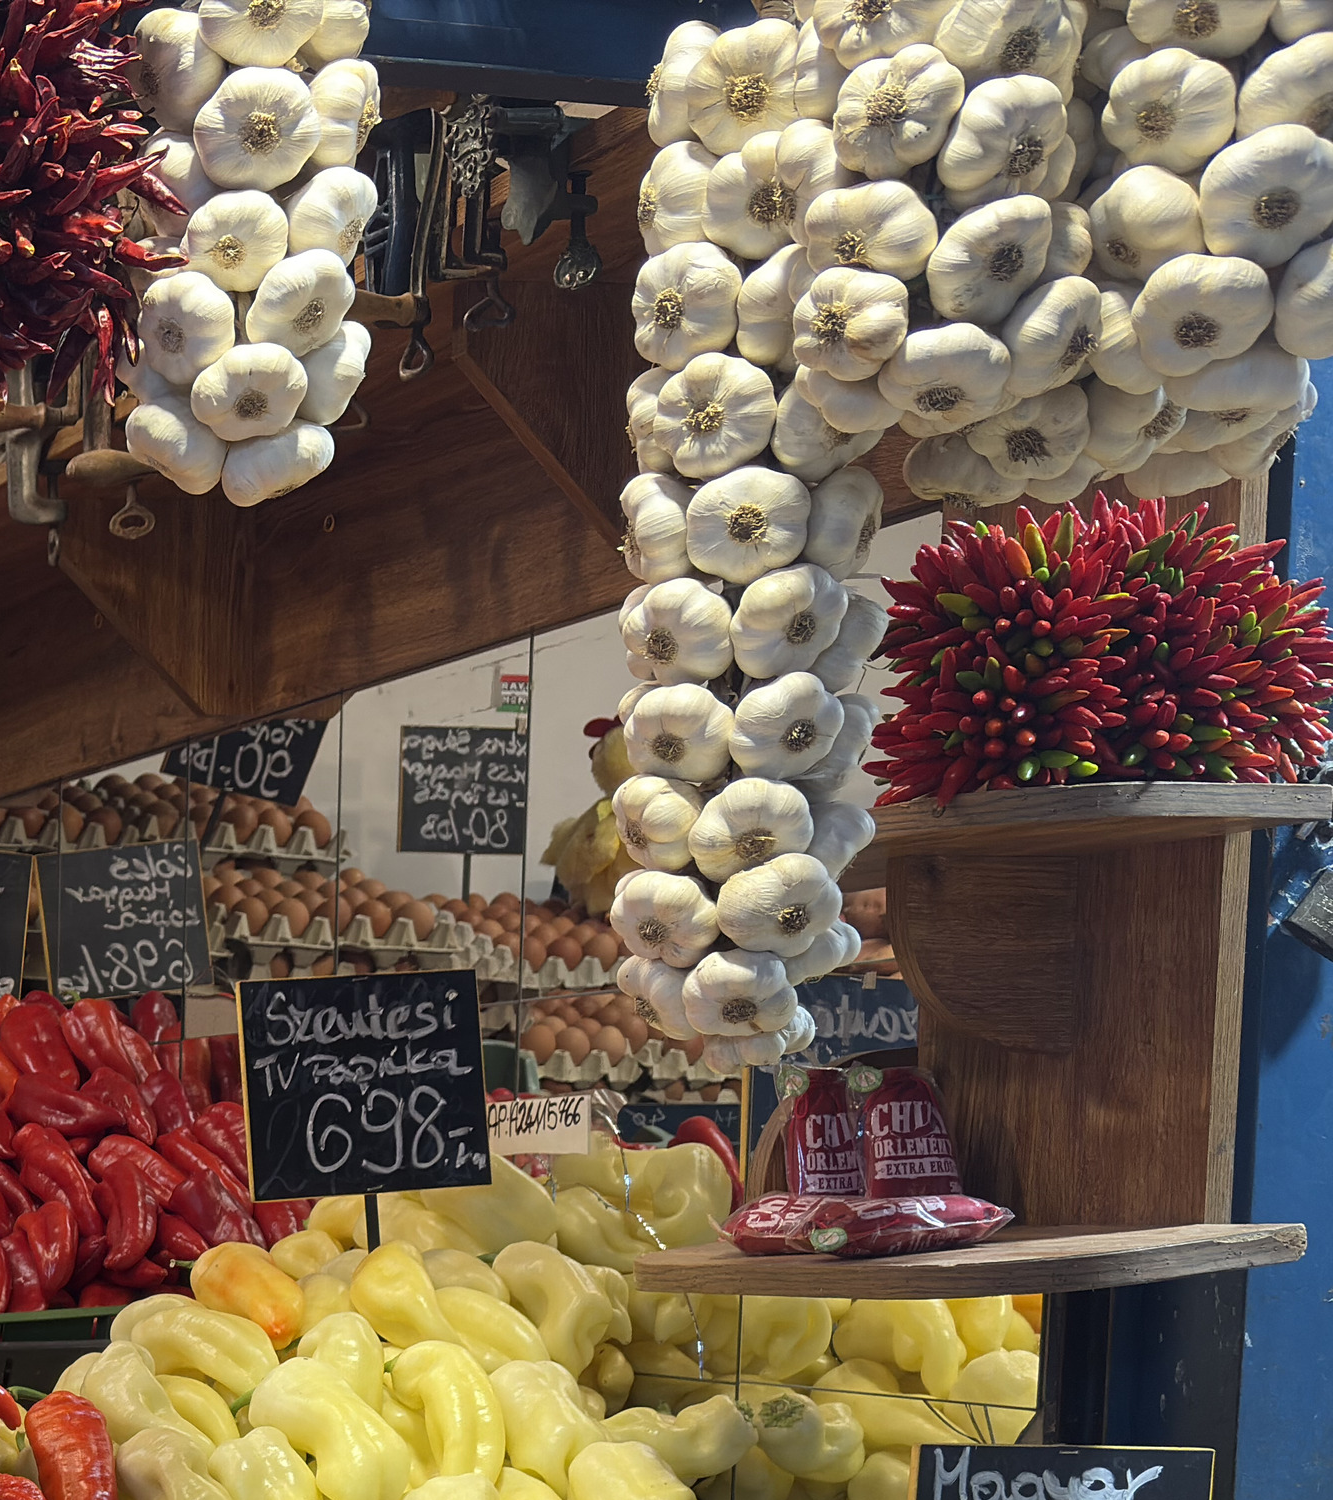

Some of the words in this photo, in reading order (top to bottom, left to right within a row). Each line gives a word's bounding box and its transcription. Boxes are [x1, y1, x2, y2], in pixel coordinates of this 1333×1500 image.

[265, 989, 459, 1047] Szentesi
[253, 1052, 300, 1096] TV
[886, 1163, 926, 1175] EXTRA
[818, 1177, 853, 1190] EXTRA
